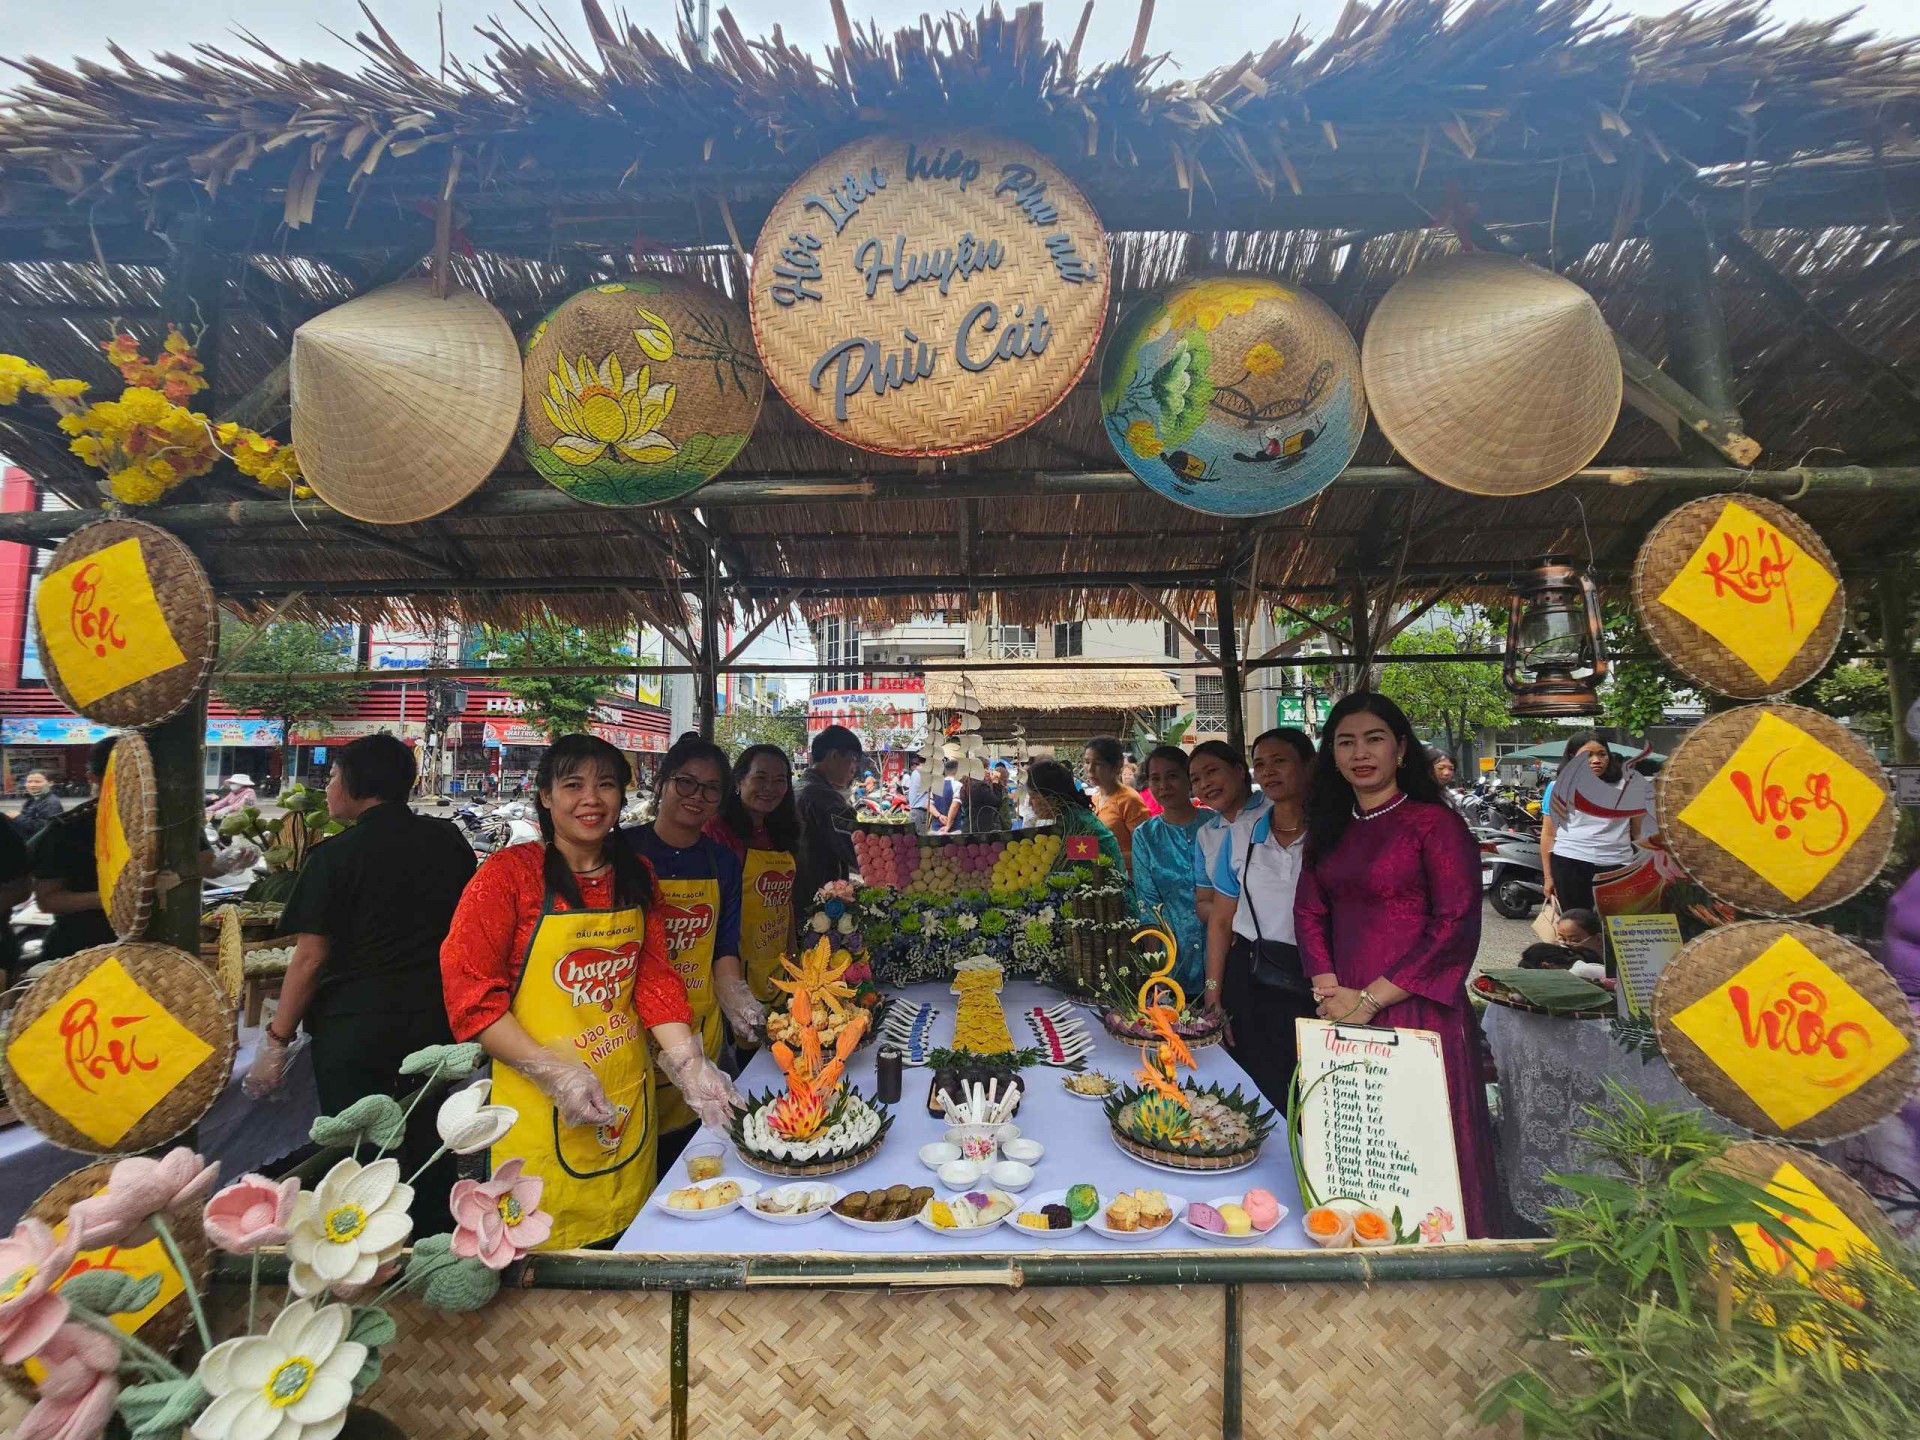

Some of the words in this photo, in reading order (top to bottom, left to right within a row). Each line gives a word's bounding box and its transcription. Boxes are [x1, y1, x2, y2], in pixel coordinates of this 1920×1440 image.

[854, 231, 1005, 297] Huyện
[809, 328, 937, 421] Phù
[955, 300, 1053, 372] Cát
[606, 928, 622, 937] CAO
[667, 931, 696, 950] oki
[567, 950, 637, 982] happi
[1332, 1074, 1358, 1087] Bánh
[1333, 1087, 1360, 1100] Bánh
[1334, 1100, 1361, 1112] Bánh
[1334, 1110, 1362, 1123] Bánh
[1334, 1121, 1362, 1134] Bánh
[1334, 1132, 1361, 1145] Bánh
[1335, 1143, 1361, 1156] Bánh
[1335, 1154, 1361, 1166] Bánh
[1338, 1165, 1363, 1177] Bánh
[1339, 1176, 1363, 1188] Bánh
[1340, 1187, 1366, 1200] Bánh
